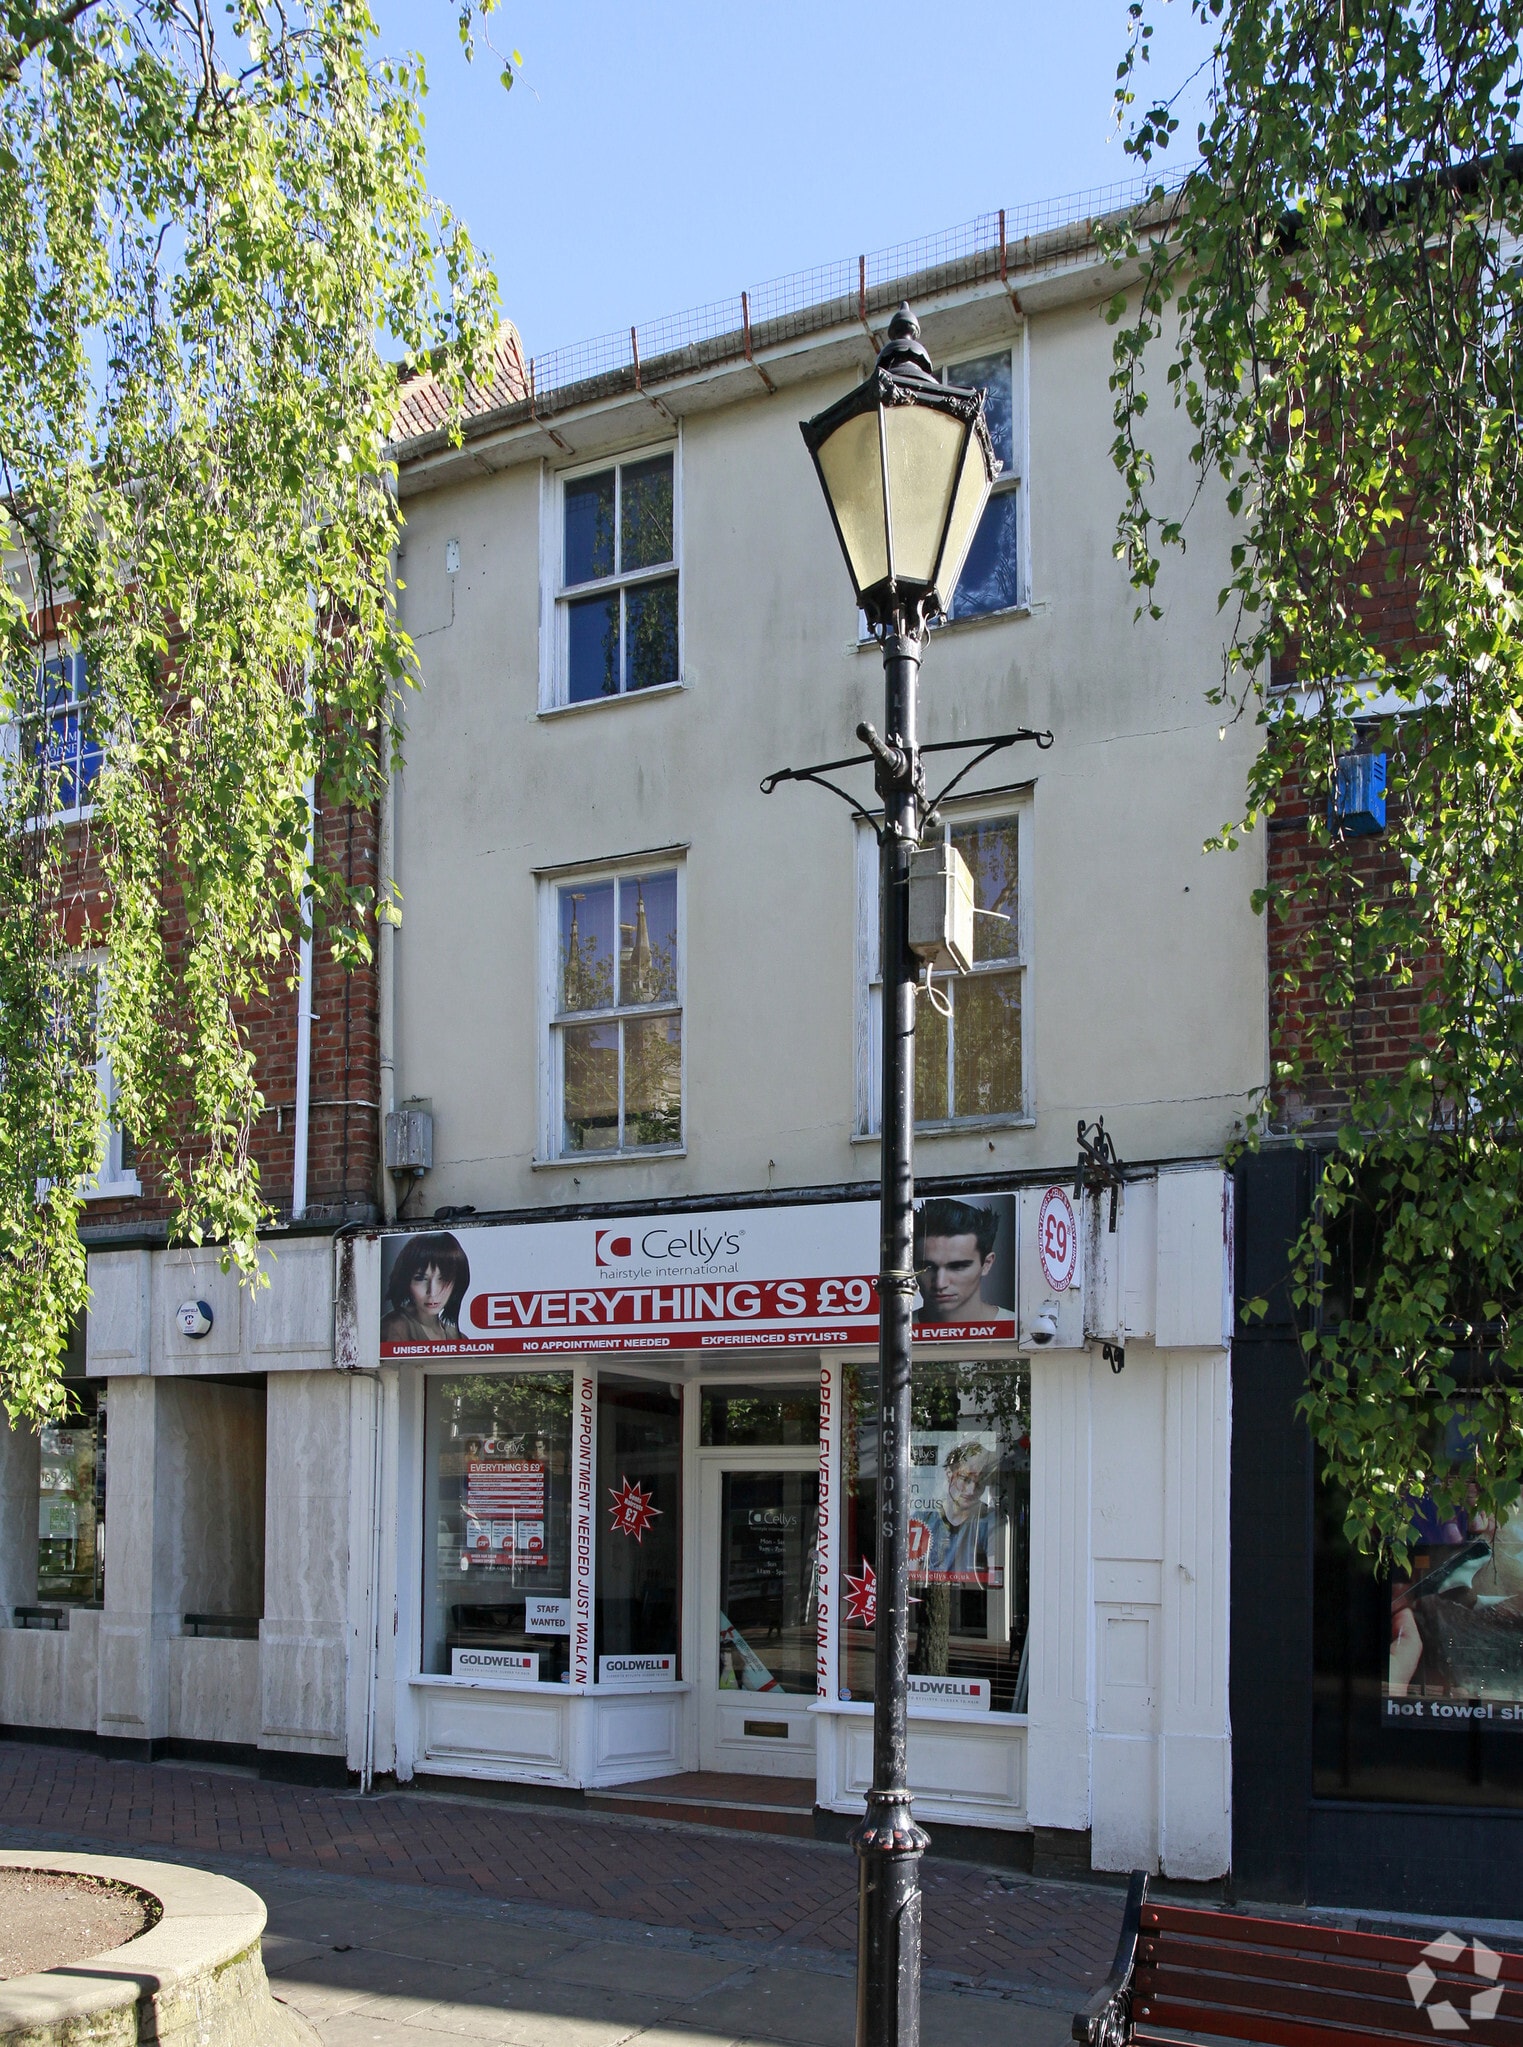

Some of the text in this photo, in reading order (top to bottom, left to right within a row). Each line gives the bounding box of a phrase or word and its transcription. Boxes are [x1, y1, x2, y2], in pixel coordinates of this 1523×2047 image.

[642, 1227, 740, 1263] Celly's
[1045, 1214, 1067, 1262] £9
[600, 1261, 739, 1281] hairstyle international
[701, 1331, 848, 1345] EXPERIENCED STYLISTS
[922, 1327, 966, 1338] EVERY
[969, 1326, 996, 1336] DAY
[393, 1343, 494, 1355] UNISEX HAIR SALON
[523, 1337, 670, 1351] NO APPOINTMENT NEEDED
[819, 1369, 831, 1431] OPEN
[818, 1438, 830, 1559] EVERYDAY
[910, 1499, 943, 1510] rcuts
[625, 1508, 638, 1522] £7
[575, 1377, 593, 1685] NO APPOINTMENT NEEDED JUST WALK IN
[911, 1527, 922, 1551] 7
[536, 1605, 560, 1614] STAFF
[530, 1617, 566, 1628] WANTED
[817, 1602, 828, 1649] SUN
[459, 1654, 522, 1668] GOLDWELL
[606, 1660, 662, 1671] GOLDWELL
[816, 1656, 827, 1698] 11-5
[907, 1682, 969, 1696] LDWELL
[1387, 1700, 1424, 1716] hot
[1430, 1702, 1493, 1719] towel
